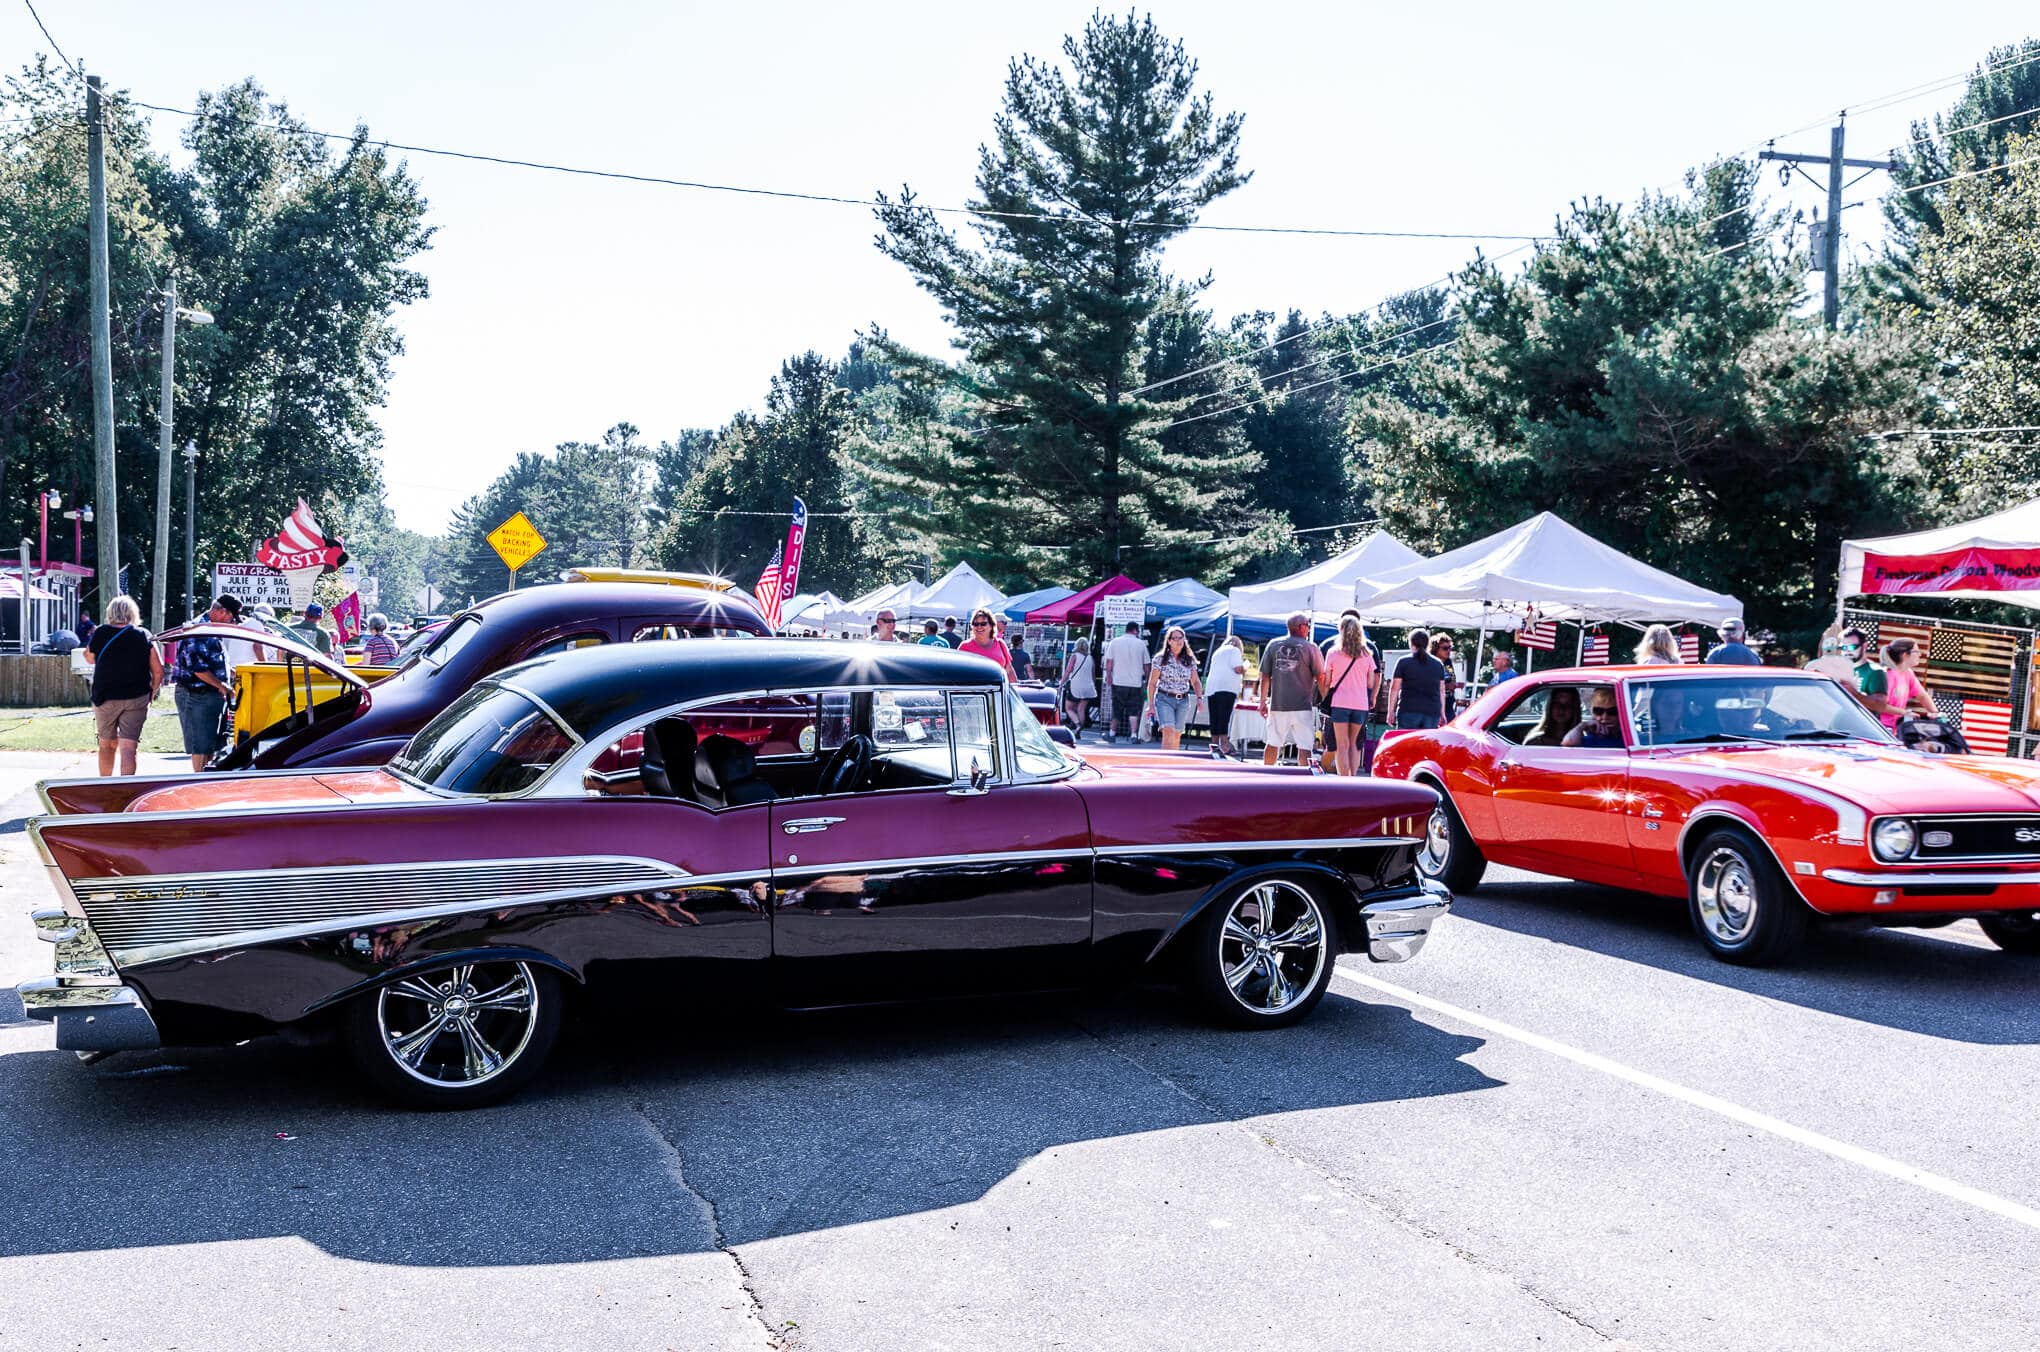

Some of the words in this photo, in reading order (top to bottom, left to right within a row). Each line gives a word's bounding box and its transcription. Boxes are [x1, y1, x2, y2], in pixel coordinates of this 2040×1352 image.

[268, 550, 328, 569] TASTY
[782, 530, 803, 596] DIPS
[221, 566, 247, 575] TASTY
[257, 577, 266, 585] IS
[221, 586, 251, 595] BUCKET
